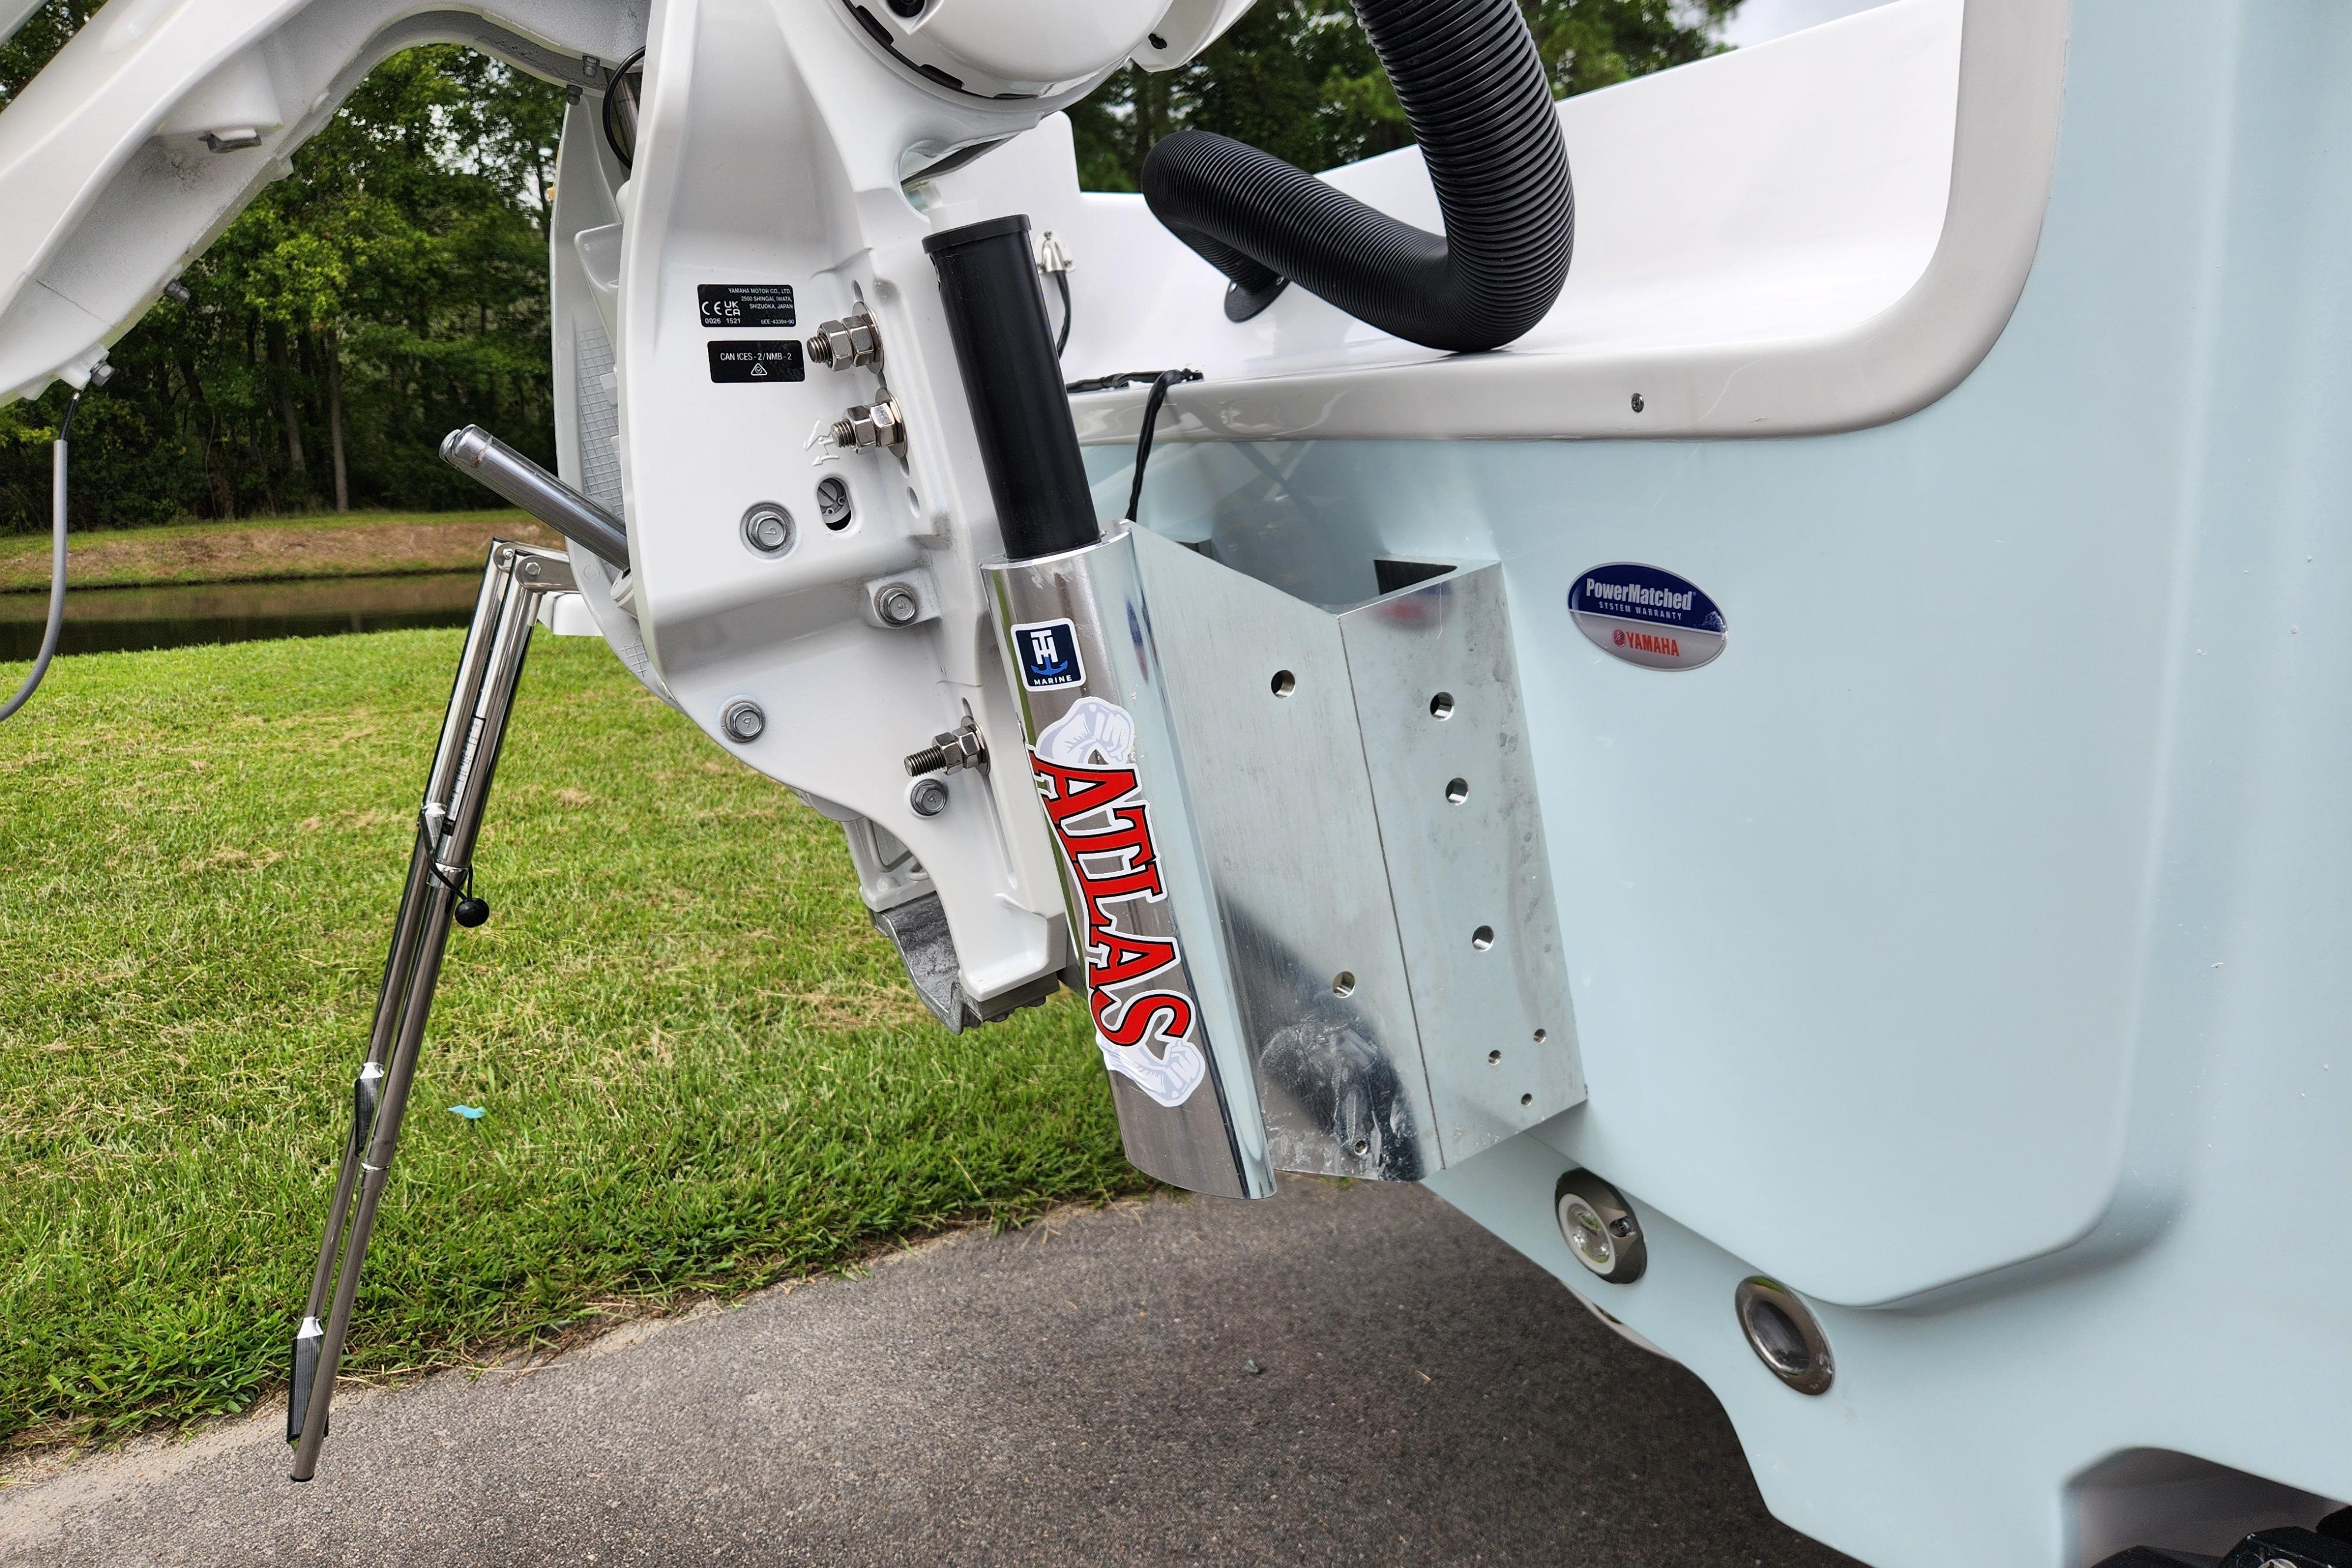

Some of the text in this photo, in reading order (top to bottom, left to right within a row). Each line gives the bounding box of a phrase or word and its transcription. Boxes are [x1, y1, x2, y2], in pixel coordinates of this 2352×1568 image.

[701, 301, 722, 315] CE
[1599, 601, 1682, 621] SYSTEM WARRANTY
[1626, 631, 1679, 657] YAMAHA
[1034, 674, 1073, 686] MARINE
[1030, 750, 1191, 1047] ATLAS
